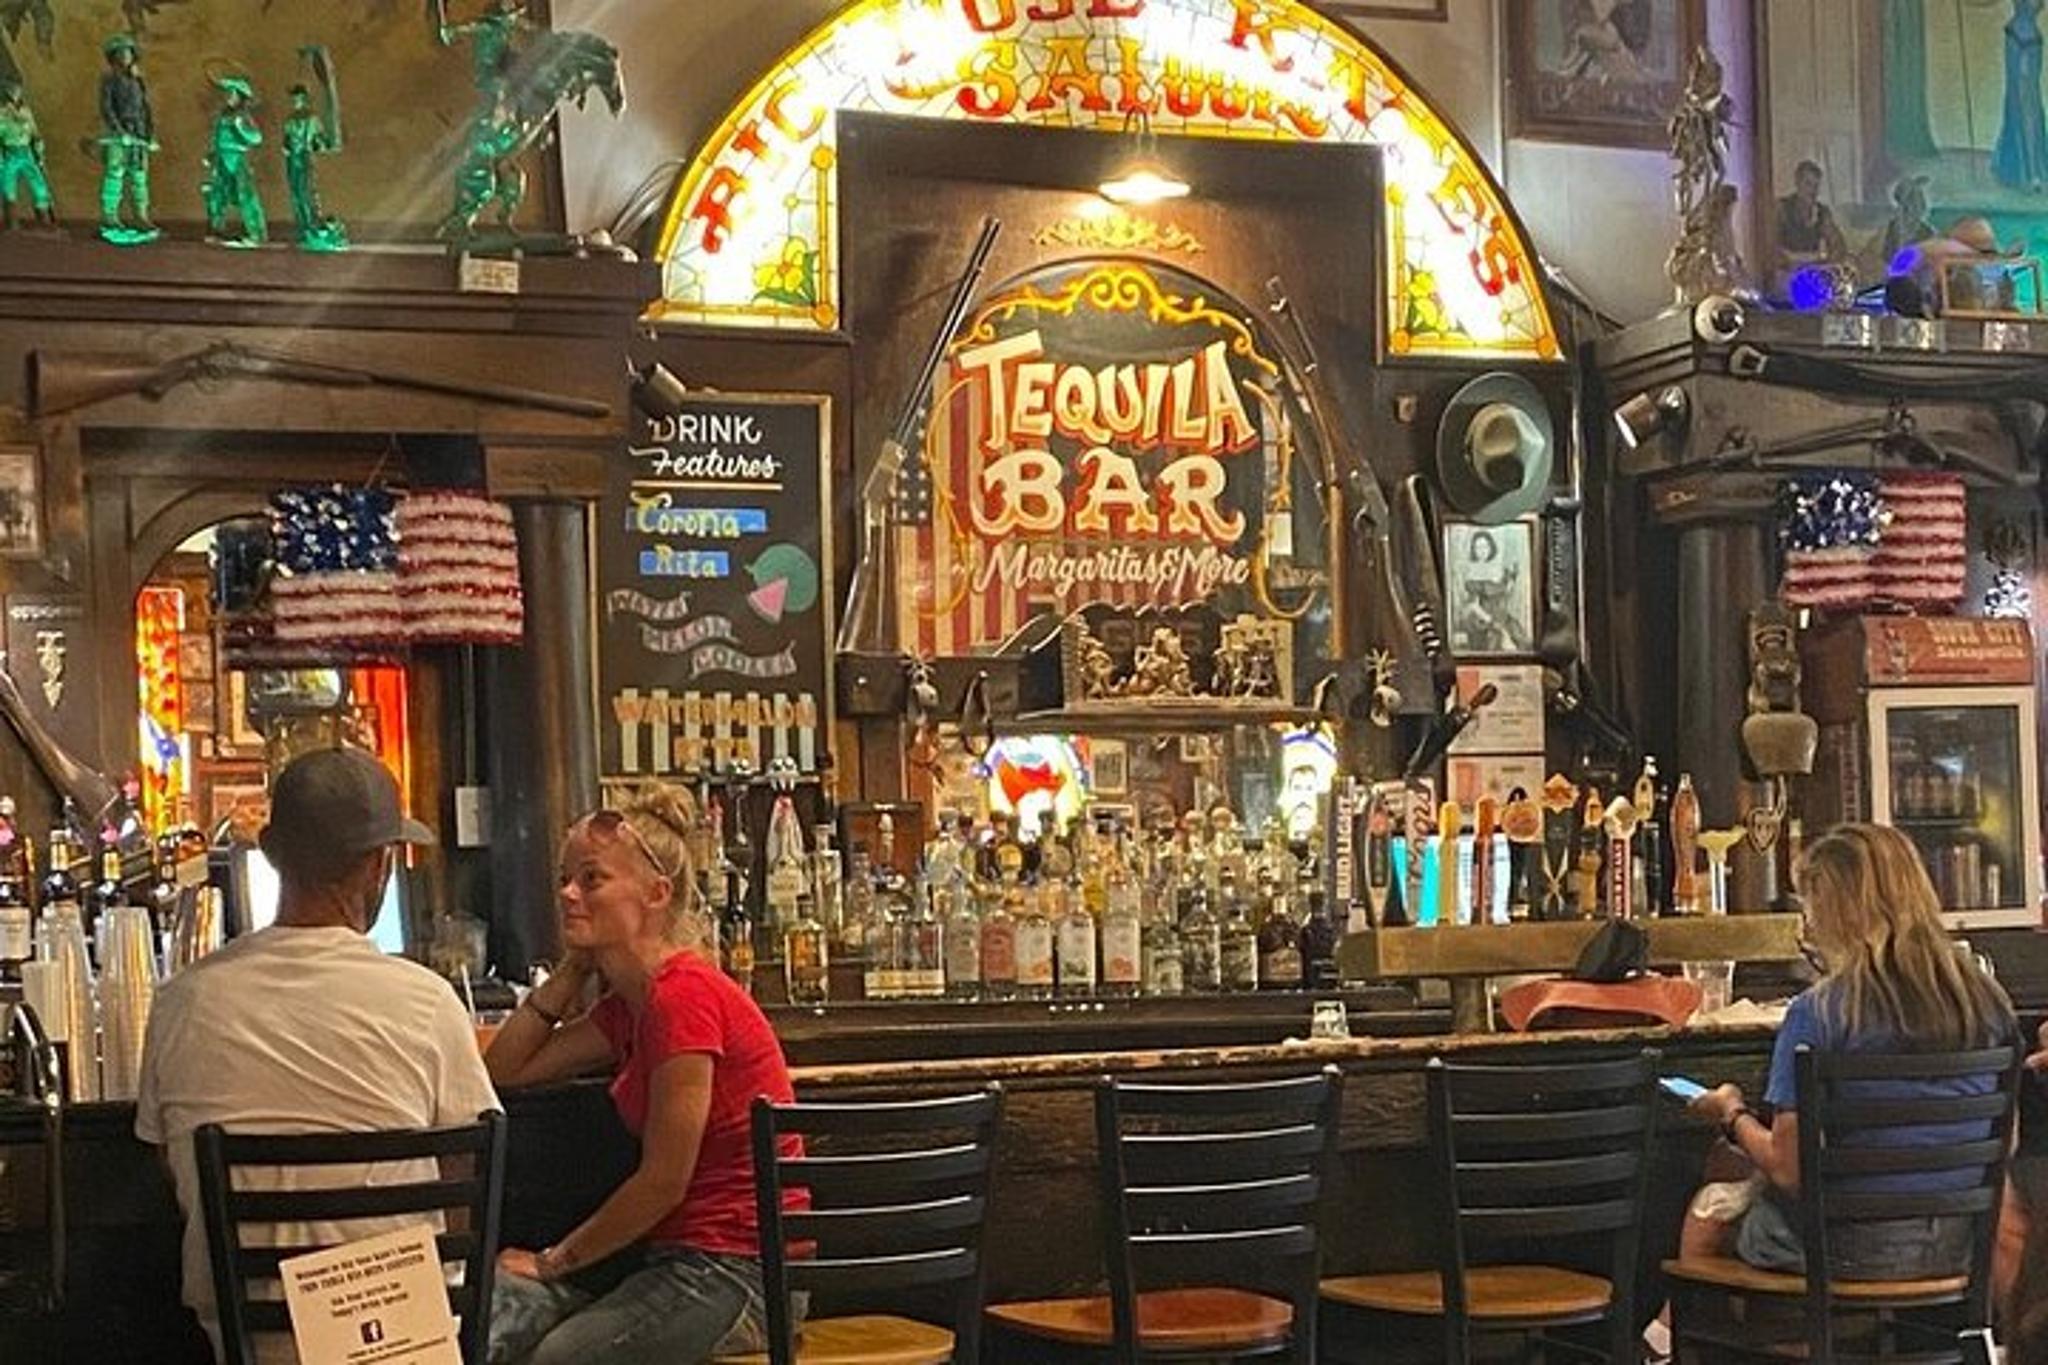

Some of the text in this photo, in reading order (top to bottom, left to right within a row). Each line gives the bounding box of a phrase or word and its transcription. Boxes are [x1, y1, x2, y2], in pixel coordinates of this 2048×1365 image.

[958, 330, 1257, 451] TEQUILA
[647, 414, 763, 445] DRINK
[628, 447, 783, 479] Features
[630, 491, 741, 538] Corona
[970, 448, 1246, 543] BAR
[654, 543, 718, 579] Rita
[1336, 795, 1352, 854] LIGHT
